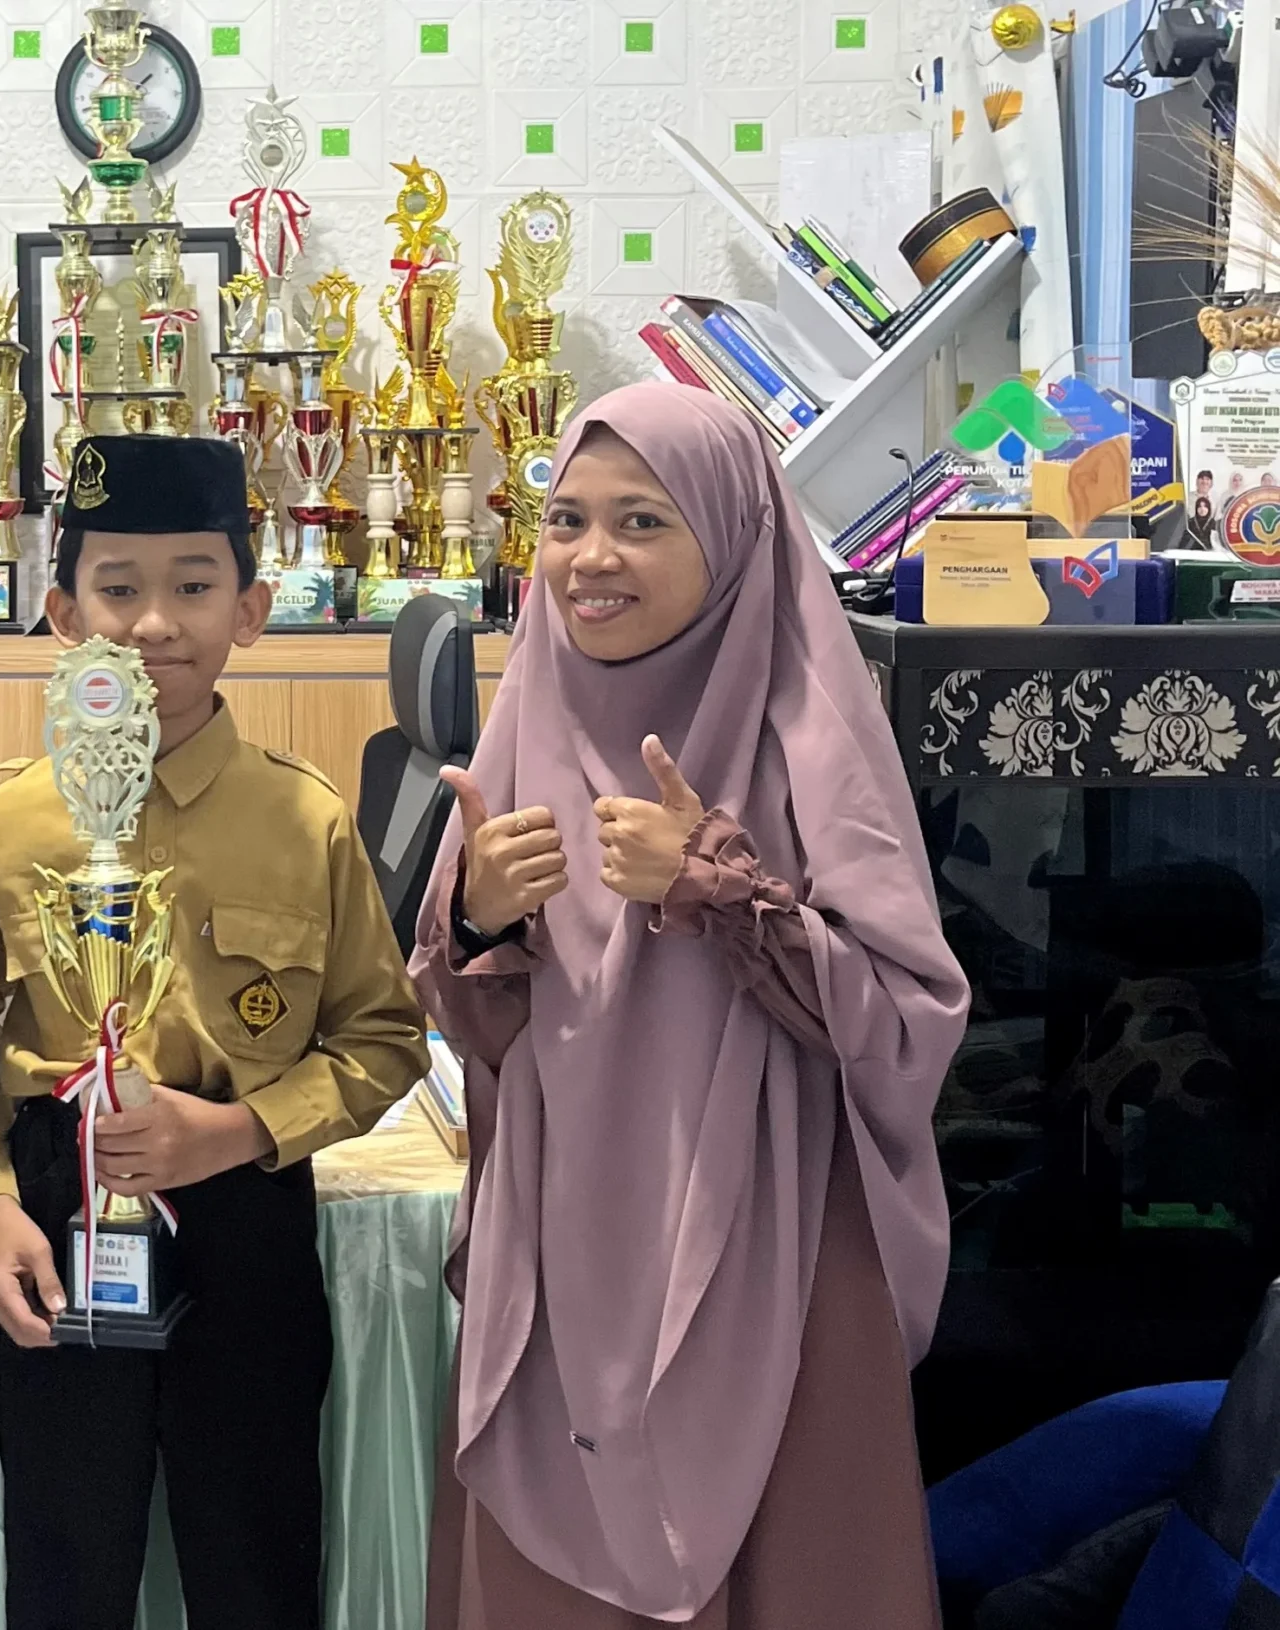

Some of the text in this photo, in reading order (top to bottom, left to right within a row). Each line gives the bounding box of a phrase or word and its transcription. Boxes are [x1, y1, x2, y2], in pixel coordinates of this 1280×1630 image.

[682, 317, 702, 339] KAMUS
[1130, 456, 1168, 468] ADANI
[942, 566, 1008, 574] PENGHARGAAN
